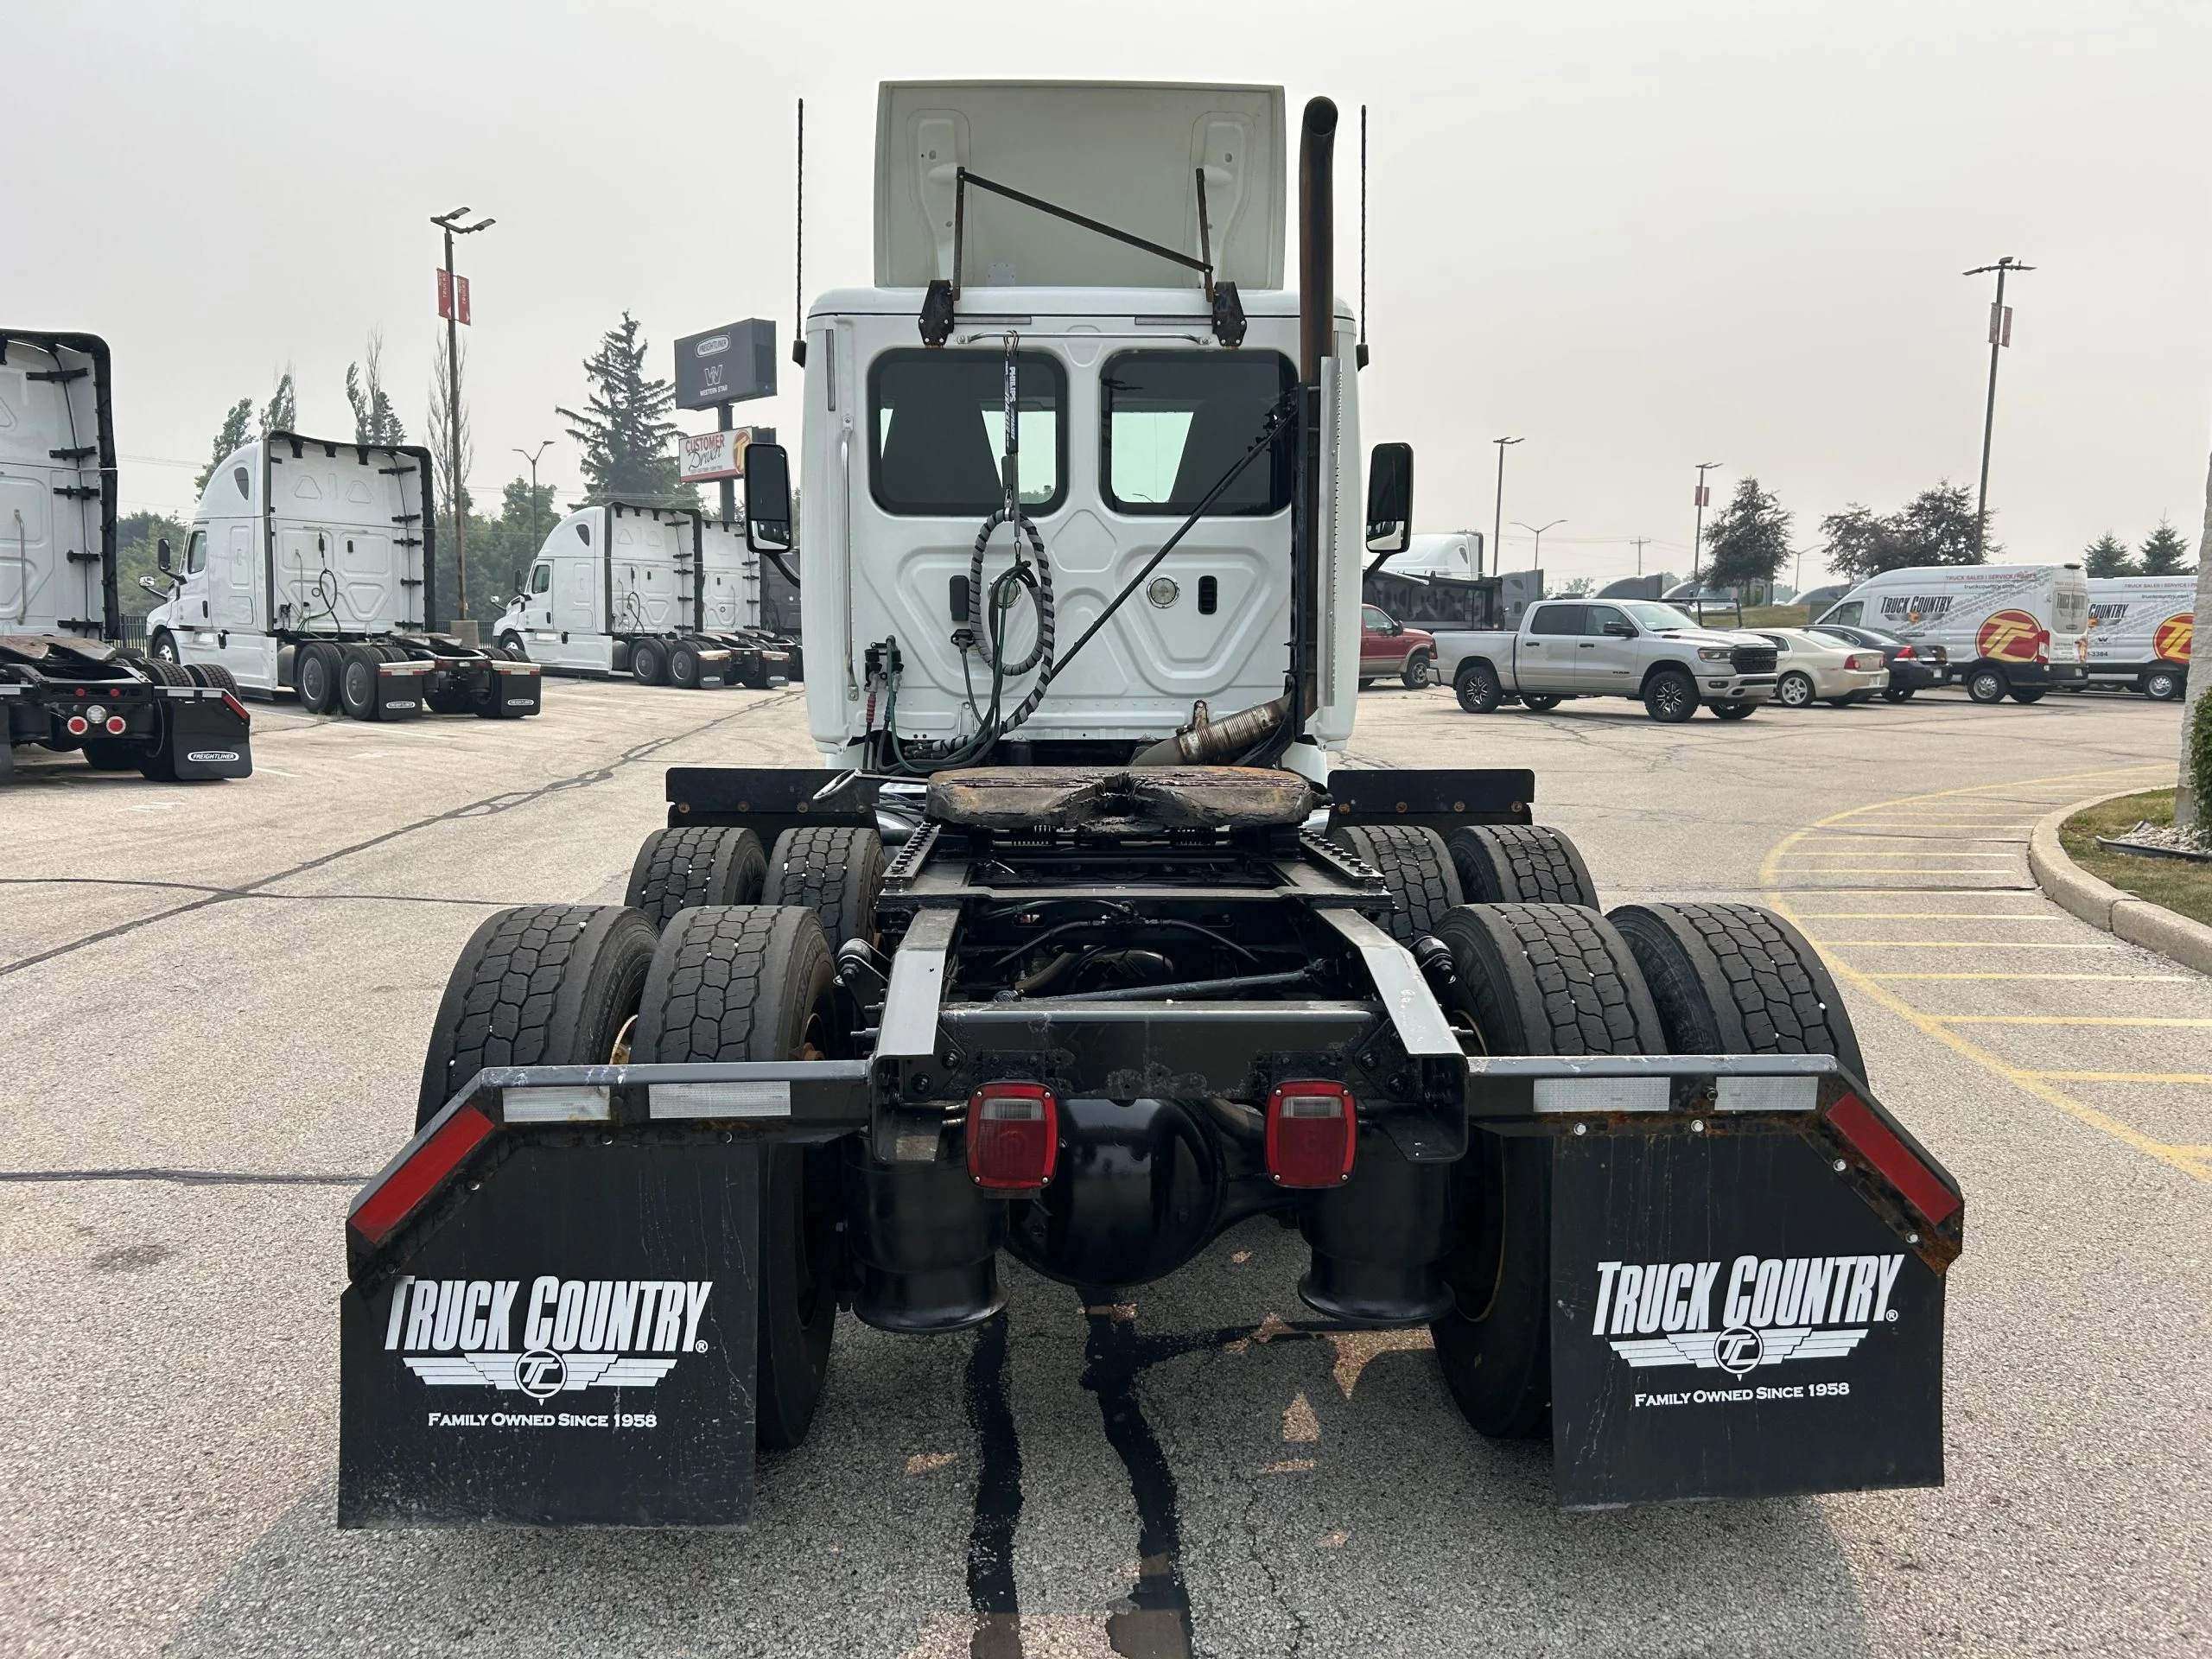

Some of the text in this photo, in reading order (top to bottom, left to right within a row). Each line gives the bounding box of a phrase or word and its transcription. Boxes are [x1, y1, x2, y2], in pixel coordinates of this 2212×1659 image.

[700, 385, 728, 397] WESTERN STAR
[685, 434, 725, 454] CUSTOMER
[1880, 595, 1954, 614] TRUCK COUNTRY
[2088, 603, 2129, 620] COUNTRY
[1592, 1254, 1905, 1336] TRUCK COUNTRY
[385, 1274, 713, 1353] TRUCK COUNTRY
[1634, 1382, 1850, 1408] FAMILY OWNED SINCE 1958
[428, 1412, 657, 1428] FAMILY OWNED SINCE 1958
